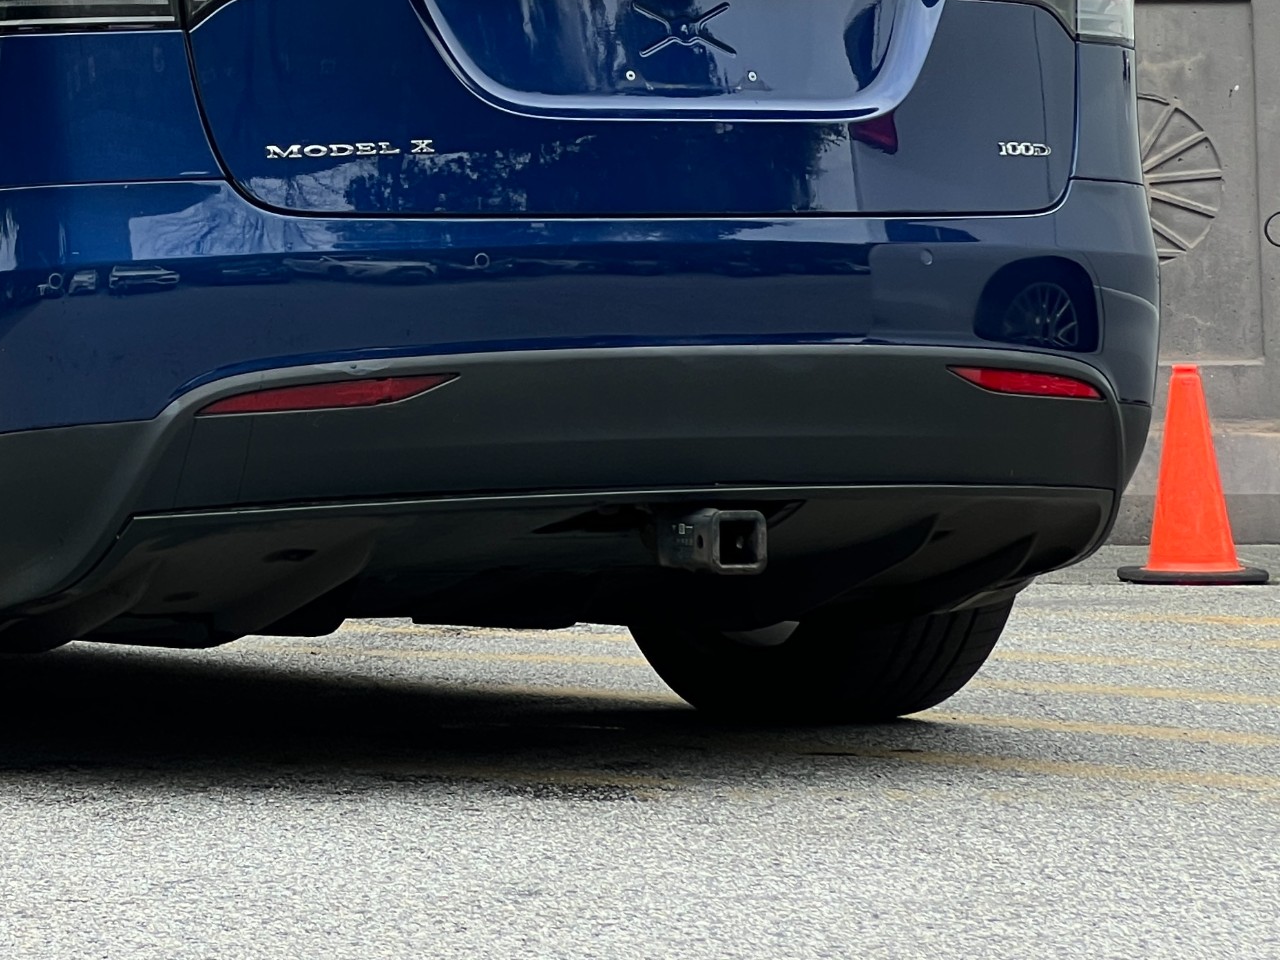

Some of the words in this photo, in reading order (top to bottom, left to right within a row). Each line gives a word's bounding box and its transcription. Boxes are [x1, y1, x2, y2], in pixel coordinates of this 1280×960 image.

[266, 142, 400, 158] MODEL
[410, 139, 435, 153] X
[998, 141, 1052, 156] 100D
